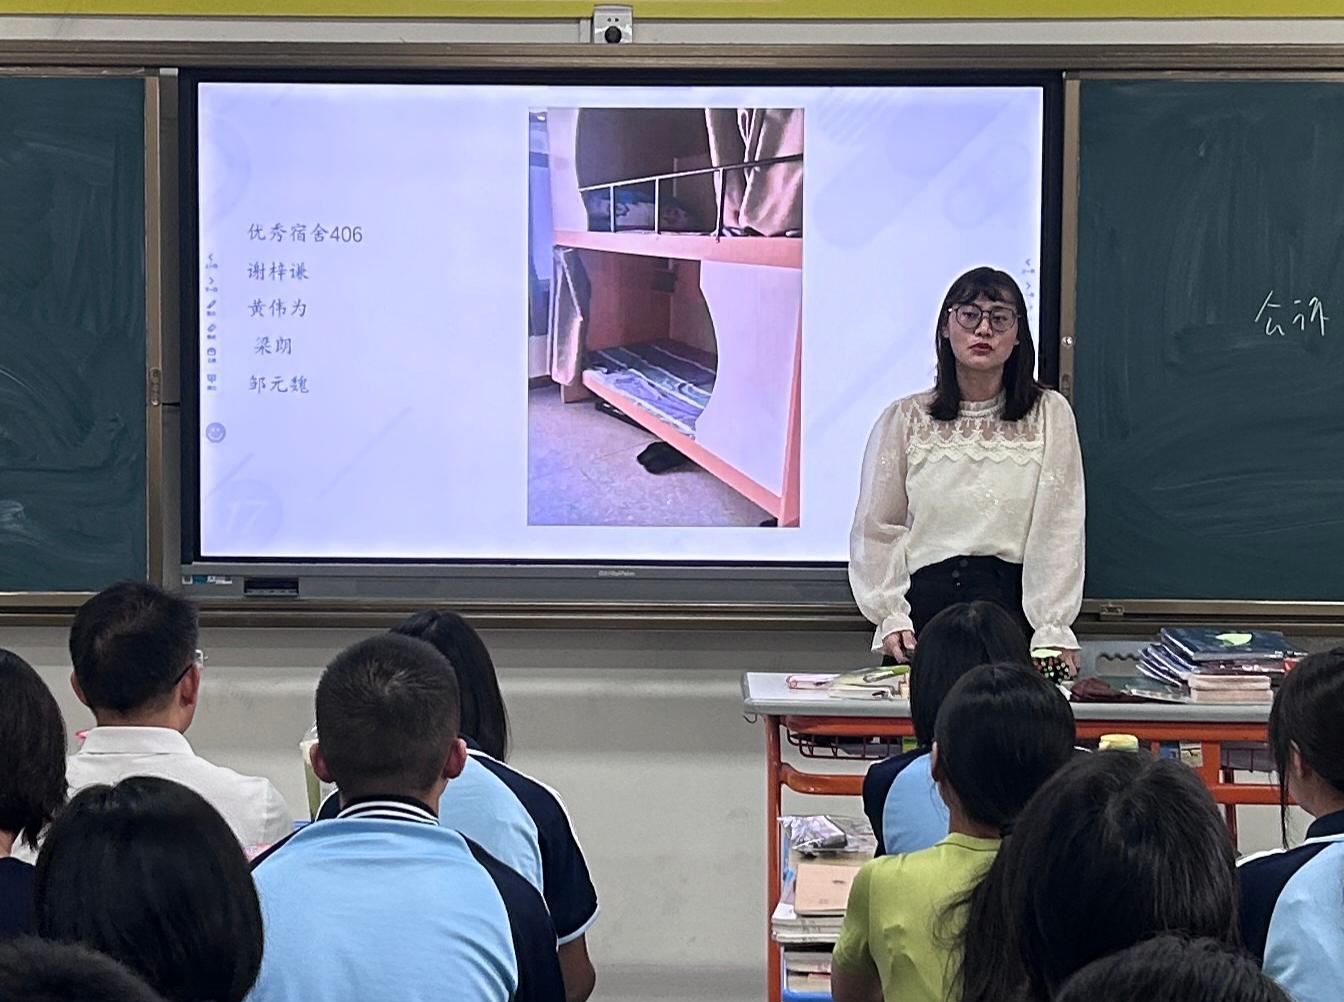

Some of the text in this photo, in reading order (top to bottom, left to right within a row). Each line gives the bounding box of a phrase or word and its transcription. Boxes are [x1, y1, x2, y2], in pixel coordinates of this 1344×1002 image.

[247, 222, 363, 243] 优秀宿舍406
[247, 261, 310, 281] 谢梓谦
[255, 335, 292, 356] 梁朗
